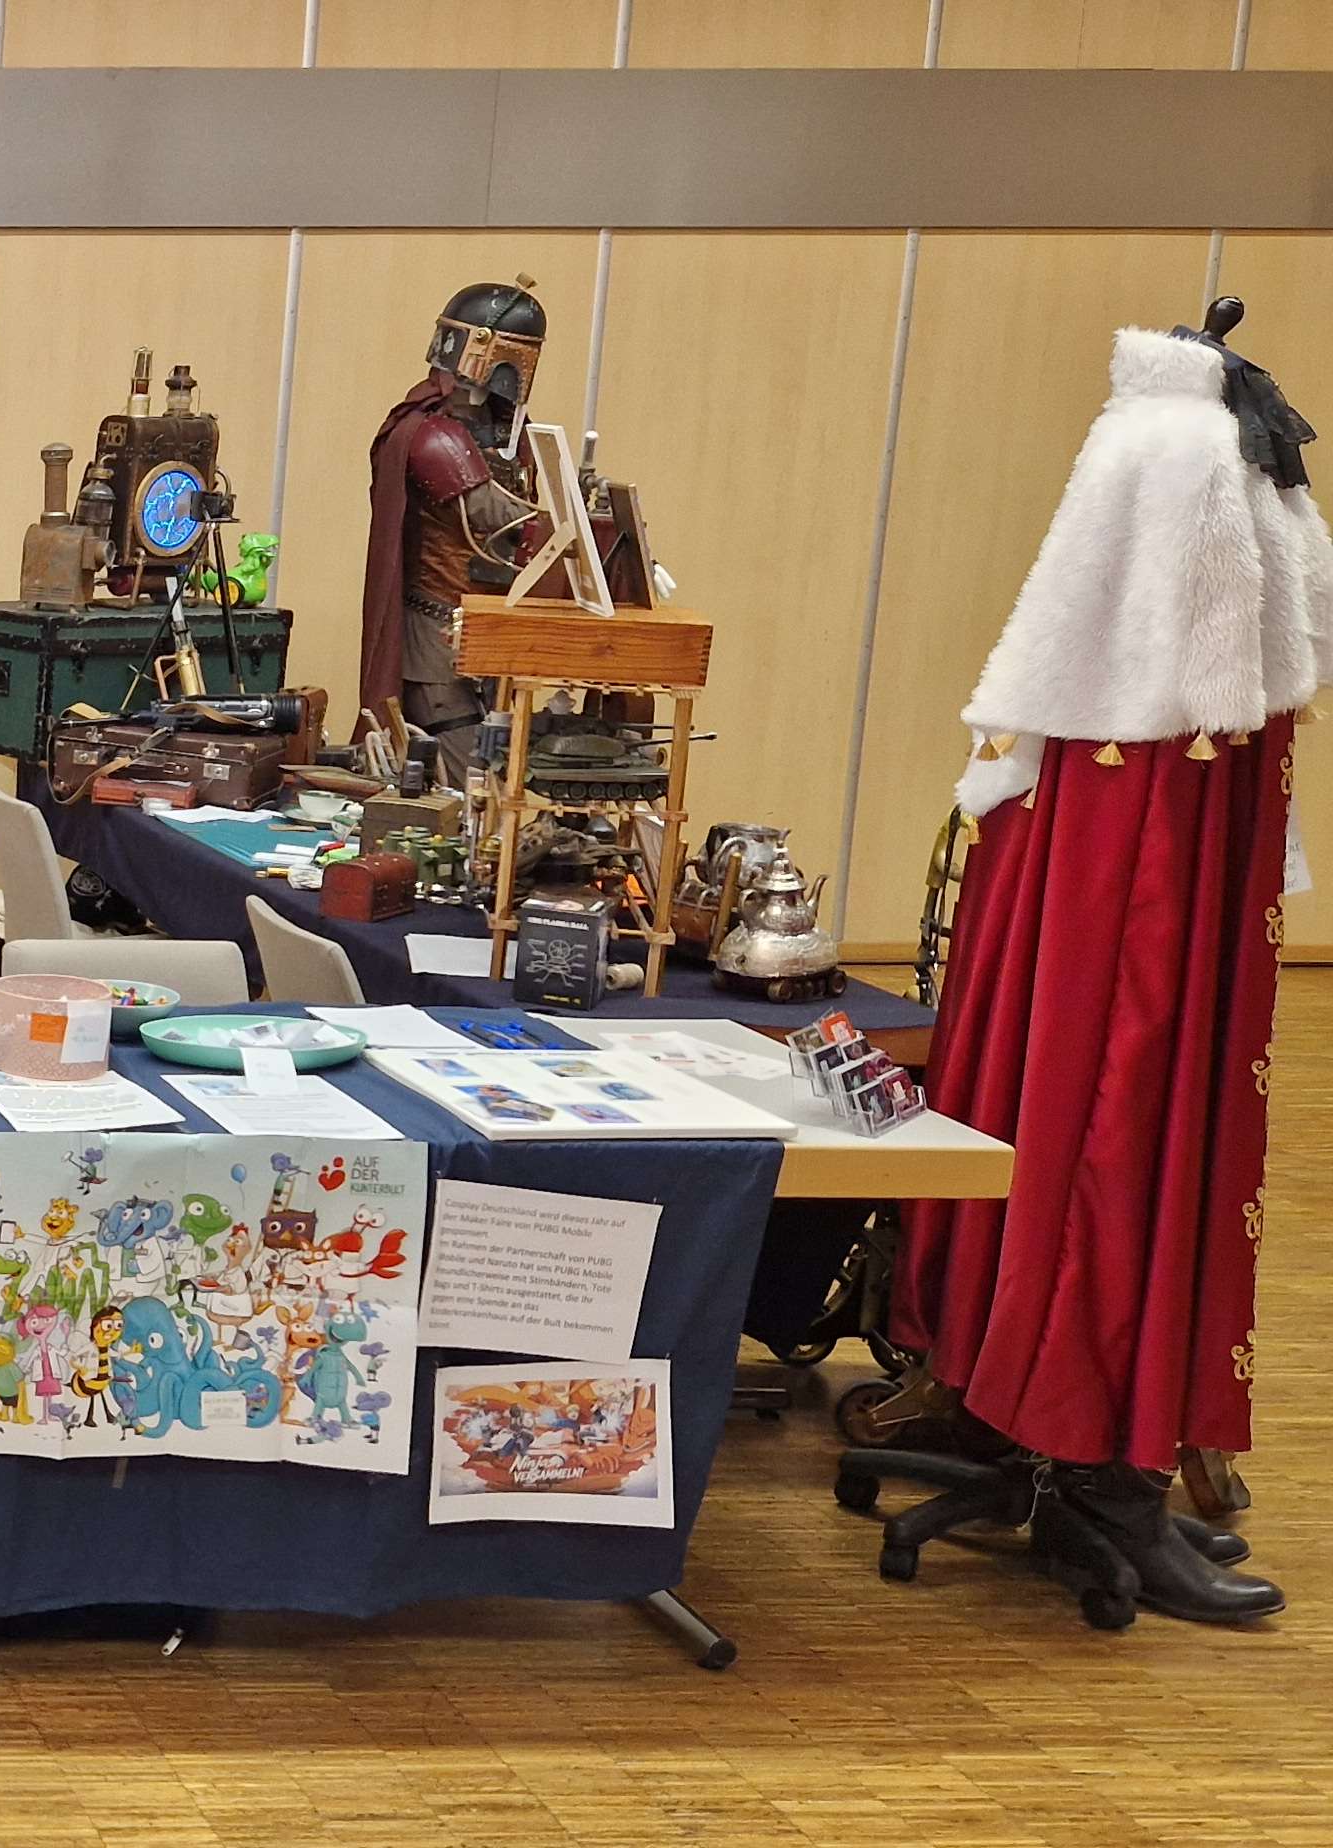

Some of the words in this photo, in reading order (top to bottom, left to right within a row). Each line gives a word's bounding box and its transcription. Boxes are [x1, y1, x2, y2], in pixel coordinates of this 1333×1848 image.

[352, 1155, 380, 1169] AUF
[350, 1167, 380, 1182] DER
[349, 1183, 406, 1196] KUNTERBULT
[444, 1199, 480, 1212] Cosplay
[481, 1203, 538, 1217] Deutschland
[539, 1211, 561, 1221] wird
[562, 1213, 590, 1224] dieses
[591, 1216, 610, 1227] Jahr
[611, 1218, 627, 1229] auf
[442, 1212, 459, 1221] der
[460, 1214, 488, 1224] Maker
[514, 1222, 532, 1231] von
[534, 1222, 560, 1235] PUBG
[561, 1226, 593, 1238] Mobile
[452, 1241, 488, 1252] Rahmen
[489, 1244, 505, 1253] der
[506, 1246, 567, 1262] Partnerschaft
[568, 1254, 585, 1264] von
[587, 1255, 613, 1267] PUBG
[468, 1256, 487, 1266] und
[487, 1257, 518, 1269] Naruto
[519, 1261, 535, 1271] hat
[536, 1264, 552, 1273] uns
[553, 1264, 580, 1277] PUBG
[581, 1268, 614, 1281] Mobile
[512, 1274, 527, 1284] mit
[591, 1283, 613, 1294] Tote
[476, 1296, 510, 1309] Spende
[510, 1301, 523, 1309] an
[524, 1303, 539, 1312] das
[564, 1294, 580, 1303] die
[509, 1314, 525, 1323] auf
[526, 1316, 543, 1325] der
[563, 1320, 614, 1336] bekommen
[513, 1466, 587, 1484] VERSAMMELN!
